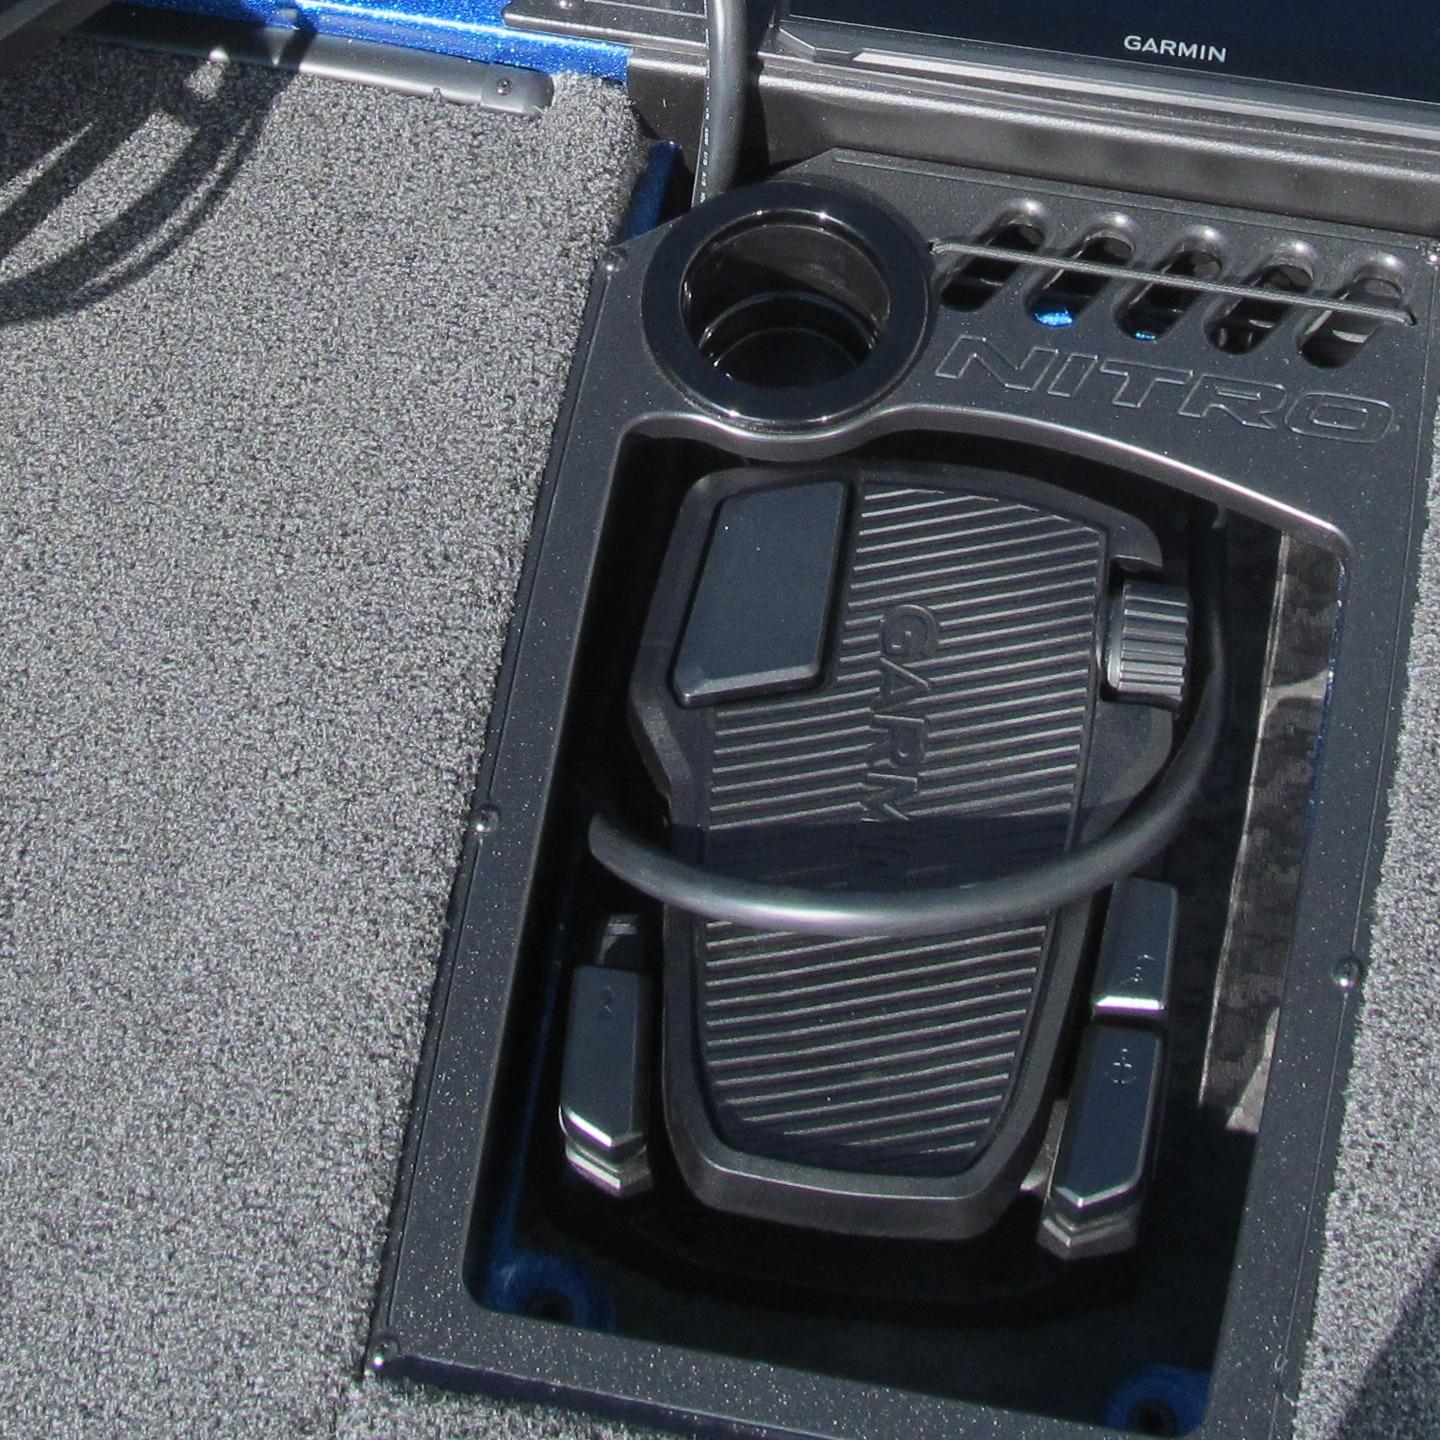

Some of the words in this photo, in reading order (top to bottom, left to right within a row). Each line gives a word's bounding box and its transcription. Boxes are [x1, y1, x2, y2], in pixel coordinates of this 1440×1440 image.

[1123, 34, 1227, 63] GARMIN
[934, 334, 1395, 444] NITRO
[857, 603, 940, 872] GARM
